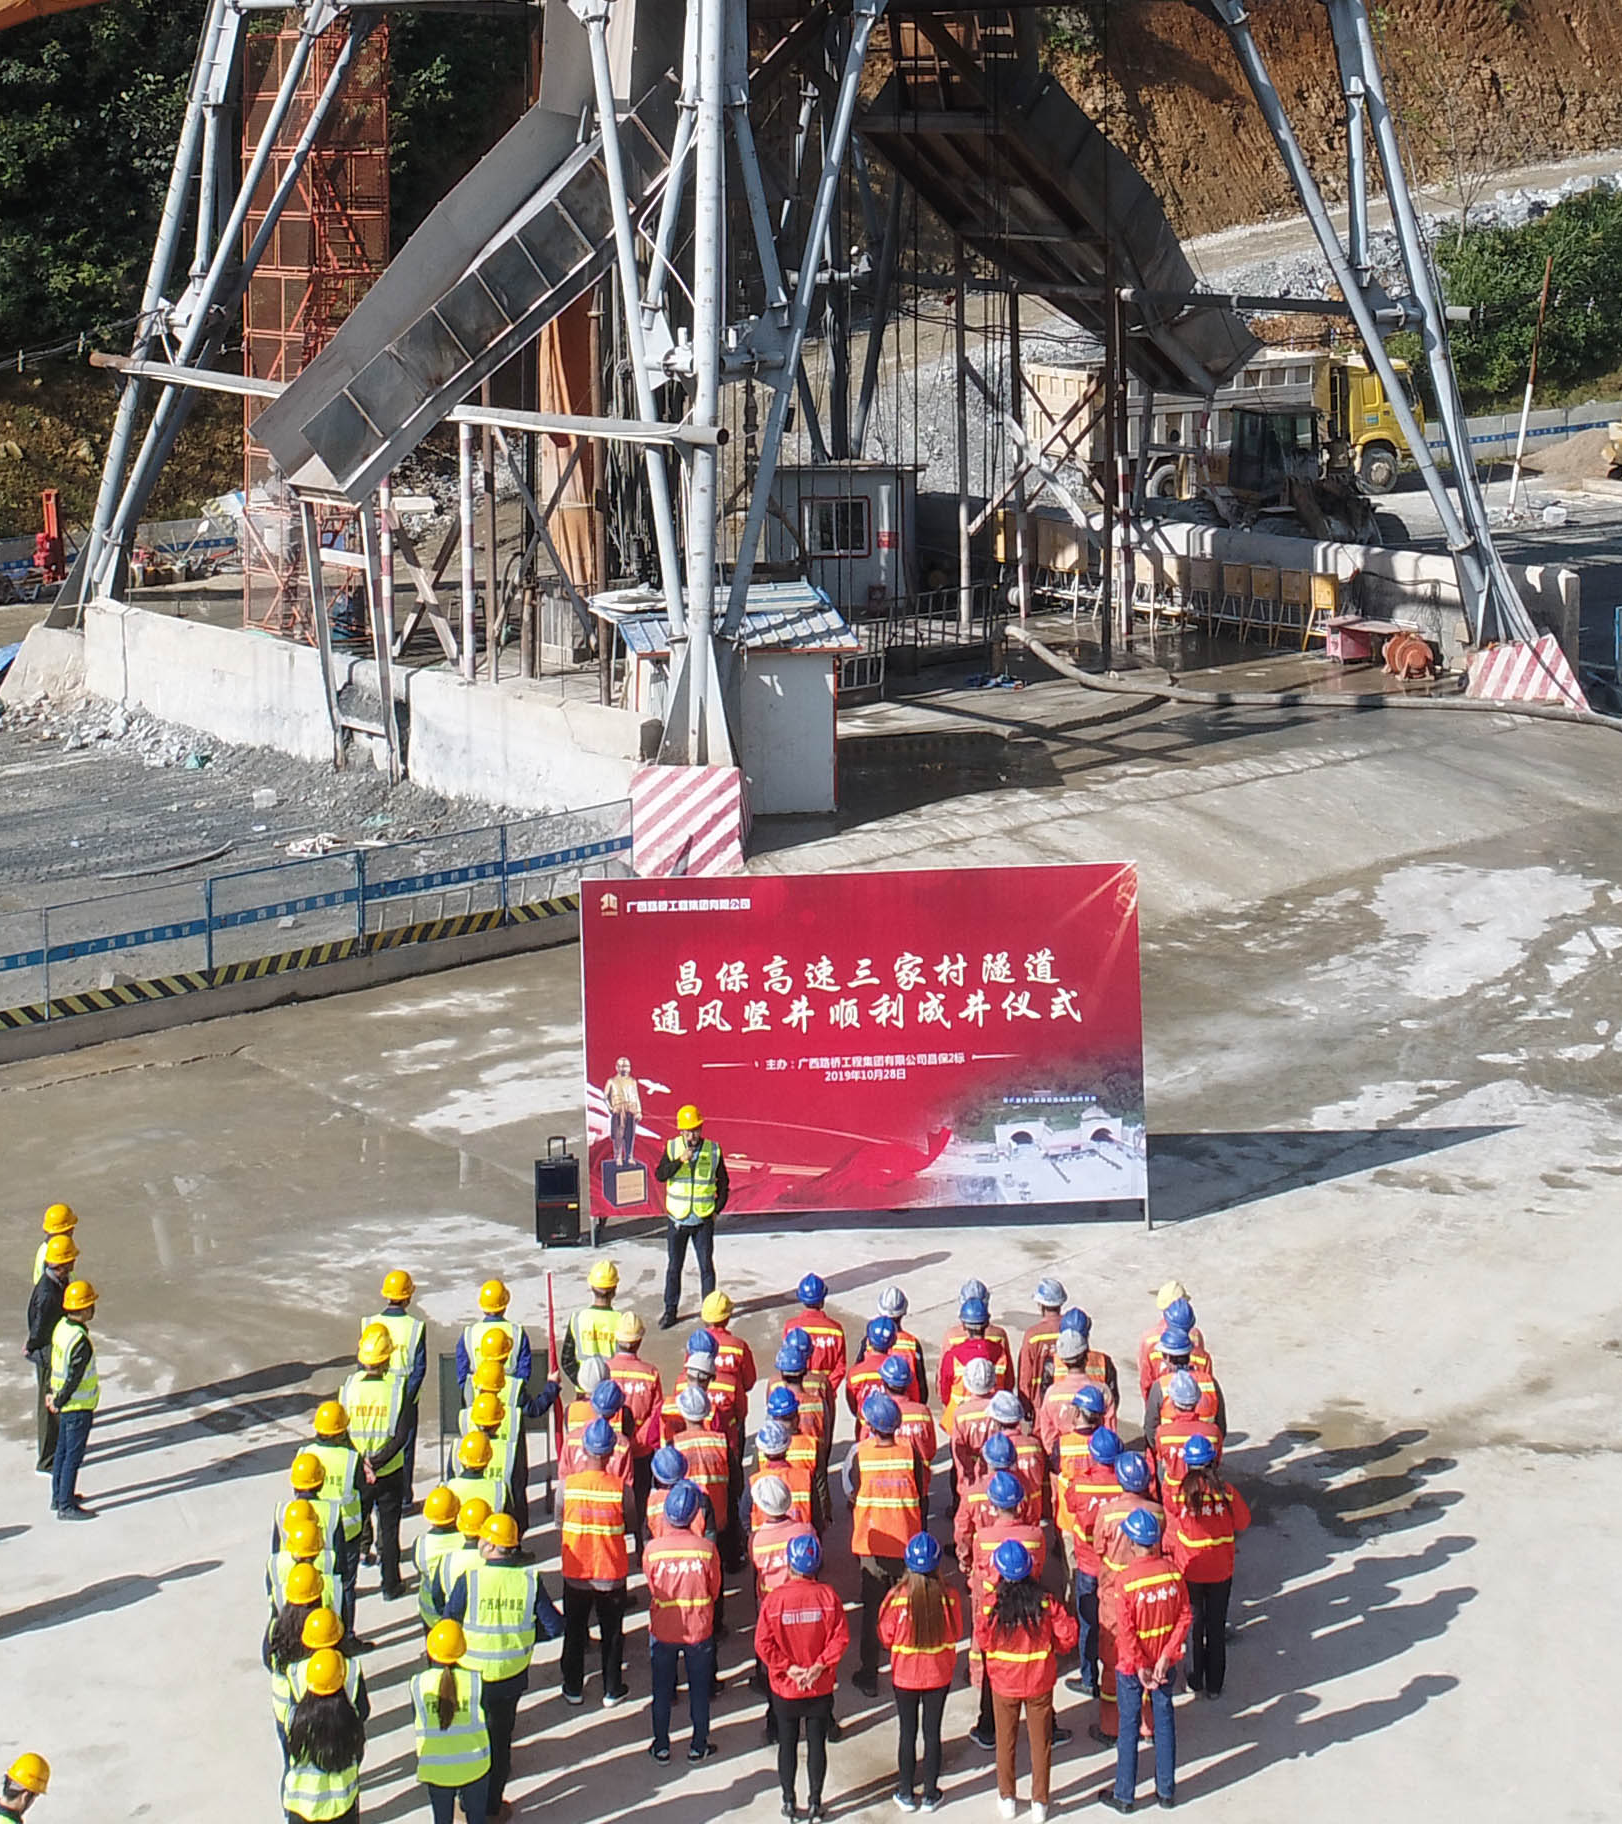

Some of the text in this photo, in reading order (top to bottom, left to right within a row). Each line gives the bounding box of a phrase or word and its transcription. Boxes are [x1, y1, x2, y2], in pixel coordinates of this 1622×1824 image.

[675, 947, 1061, 996] 昌保高速三家村隧道
[651, 987, 1083, 1035] 通风竖井顺利成井仪式
[825, 1068, 906, 1082] 2019年10月28日
